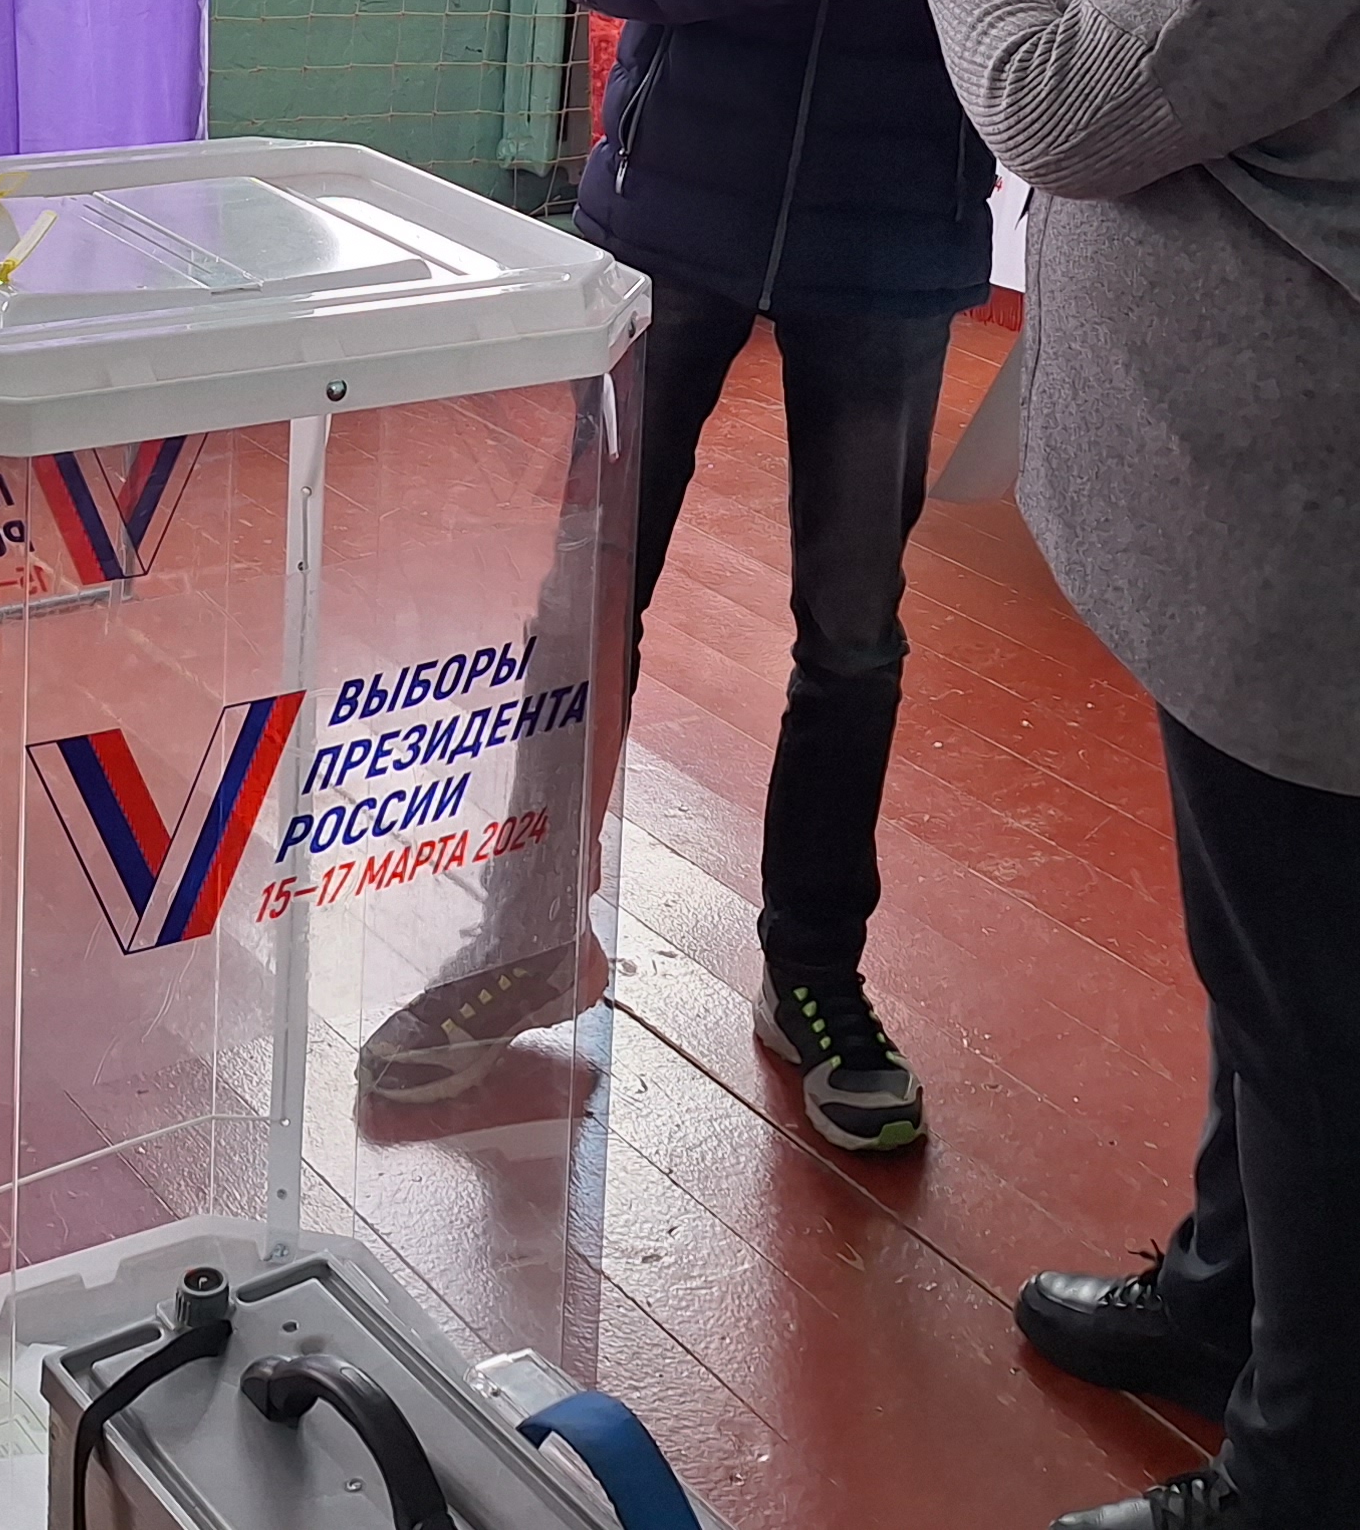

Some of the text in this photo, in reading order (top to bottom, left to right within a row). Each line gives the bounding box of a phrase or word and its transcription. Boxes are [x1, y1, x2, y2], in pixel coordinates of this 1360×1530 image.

[328, 635, 537, 727] ВЫБОРЫ
[301, 680, 590, 795] ПРЕЗИДЕНТА
[275, 772, 471, 864] РОССИИ
[355, 830, 471, 896] МАРТА
[472, 807, 549, 863] 2024
